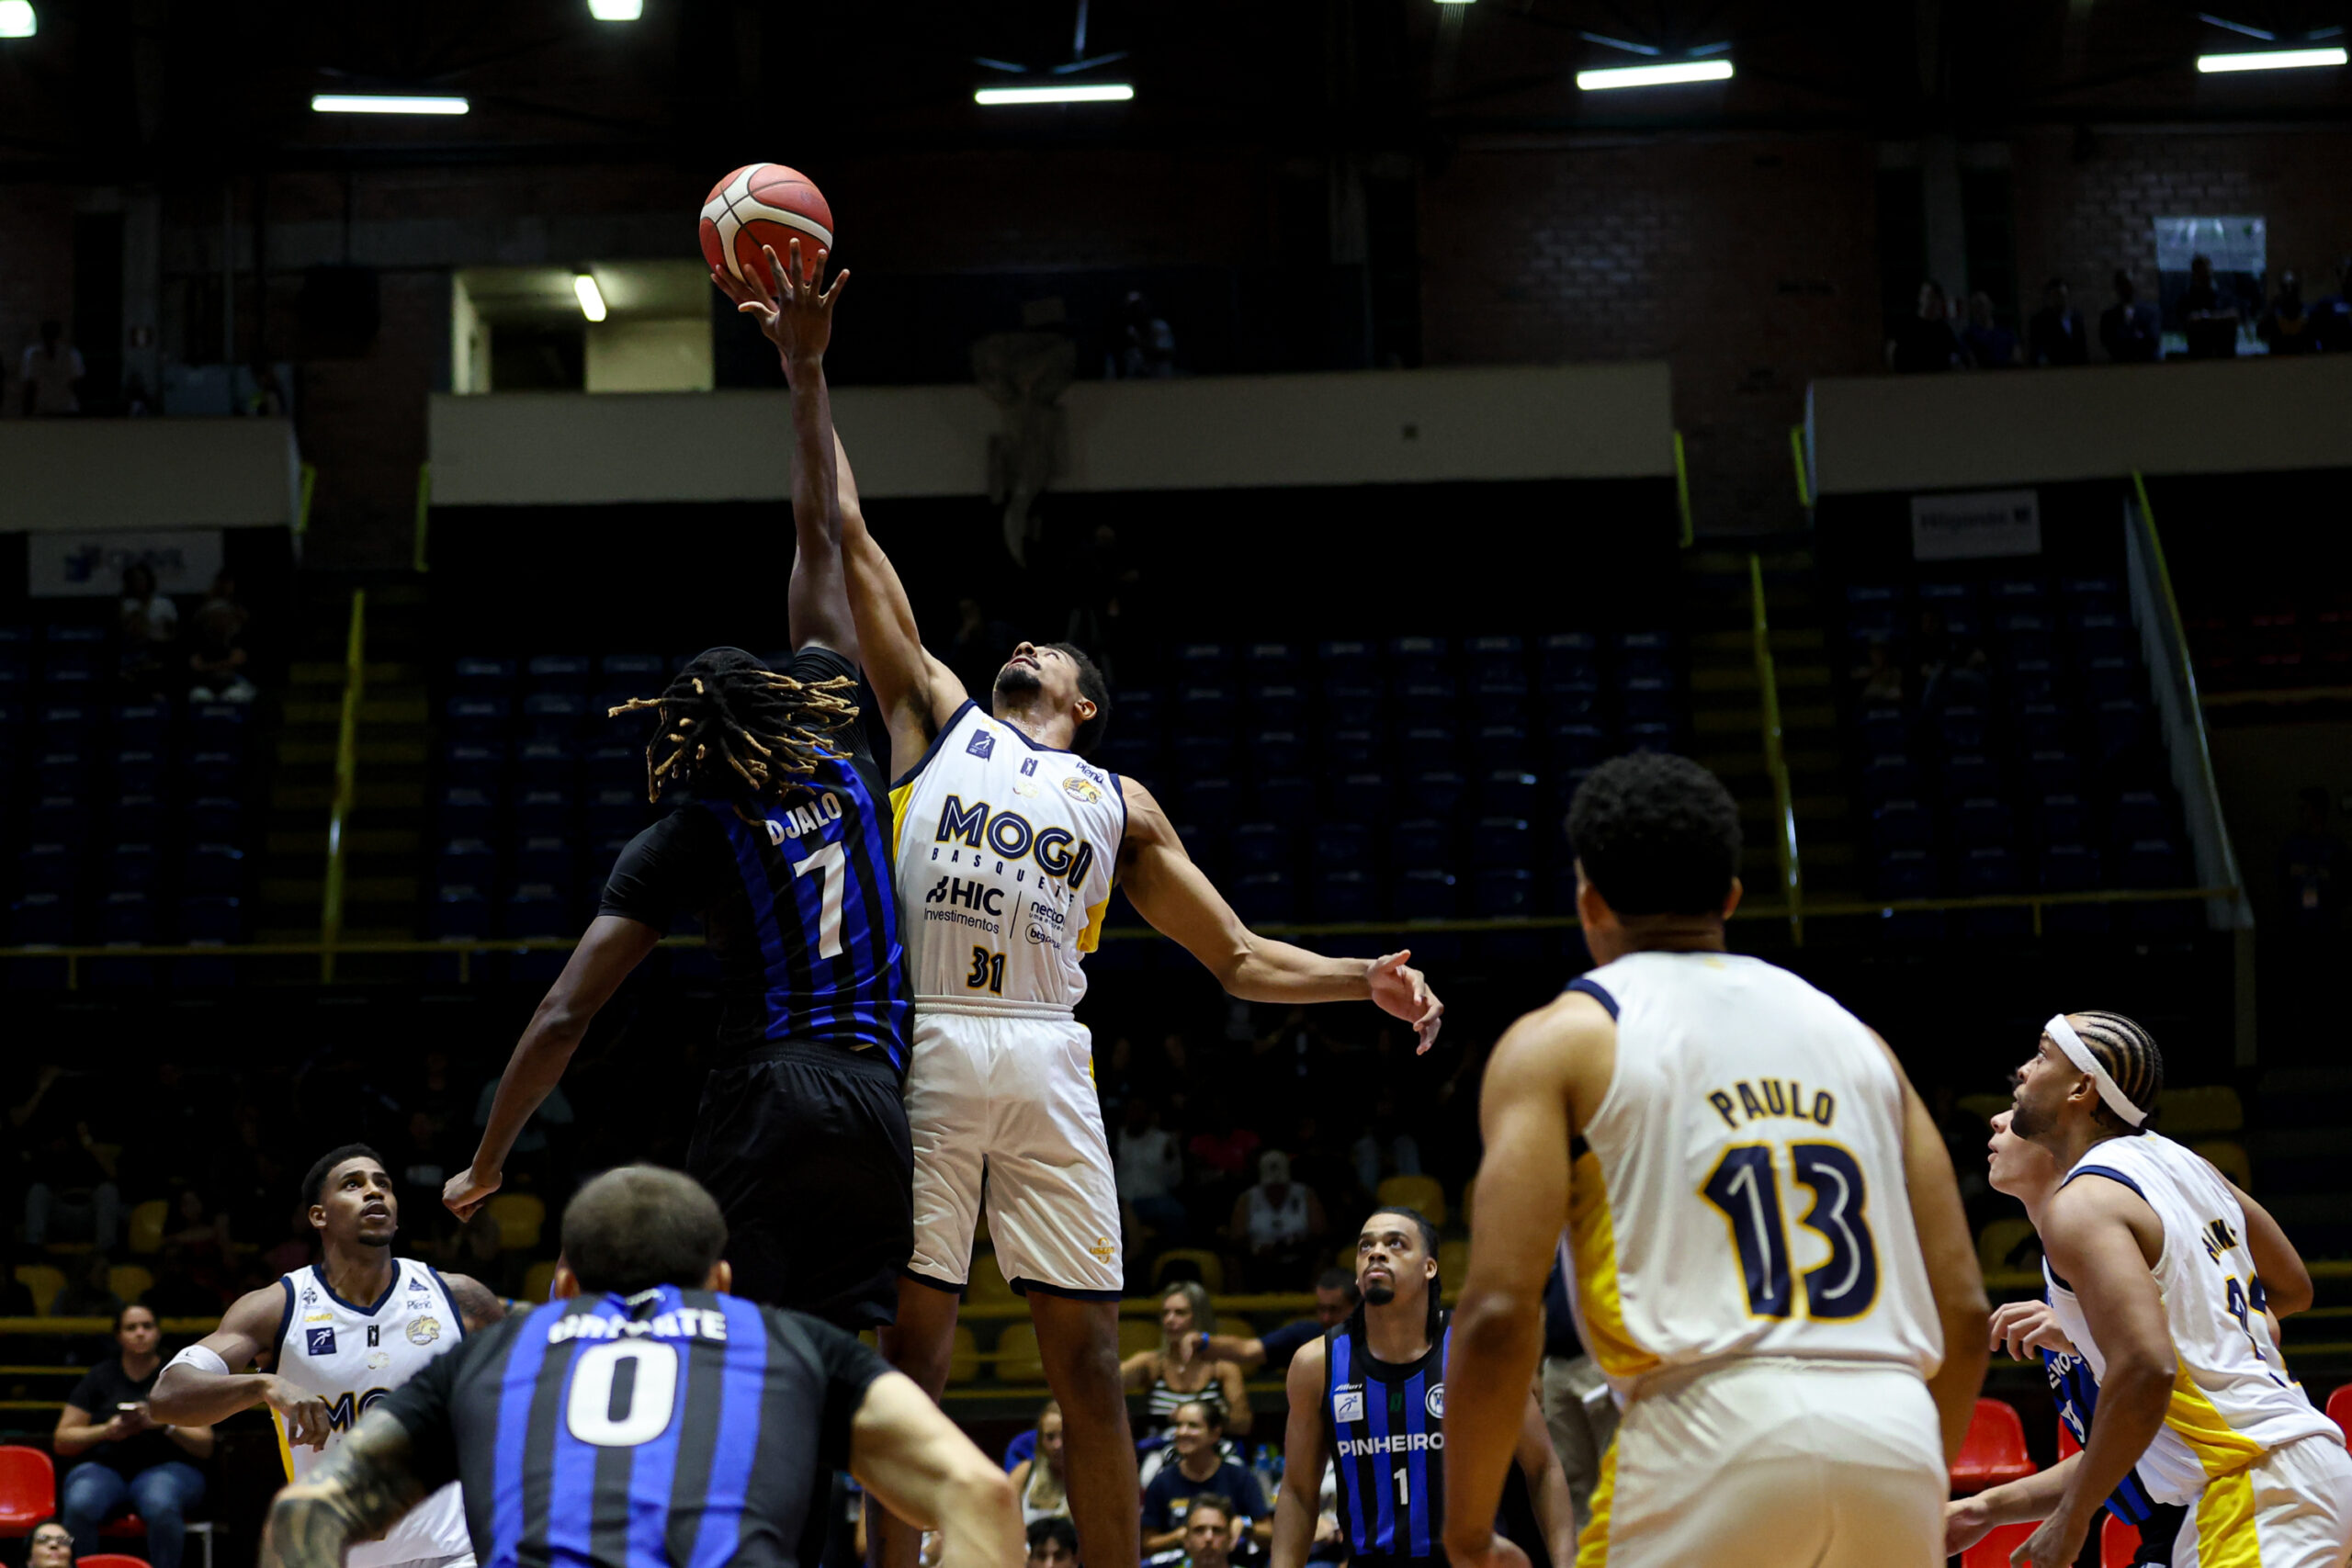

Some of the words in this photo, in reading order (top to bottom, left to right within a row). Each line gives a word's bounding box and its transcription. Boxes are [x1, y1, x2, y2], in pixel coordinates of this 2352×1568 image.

[765, 792, 843, 846] DJALO
[935, 794, 1094, 890] MOGI
[793, 840, 846, 960] 7
[924, 908, 1000, 935] Investimentos
[950, 877, 1005, 917] HIC
[967, 945, 1007, 996] 31
[1706, 1077, 1837, 1130] PAULO
[1697, 1138, 1881, 1325] 13
[567, 1337, 678, 1448] 0
[1393, 1467, 1409, 1506] 1
